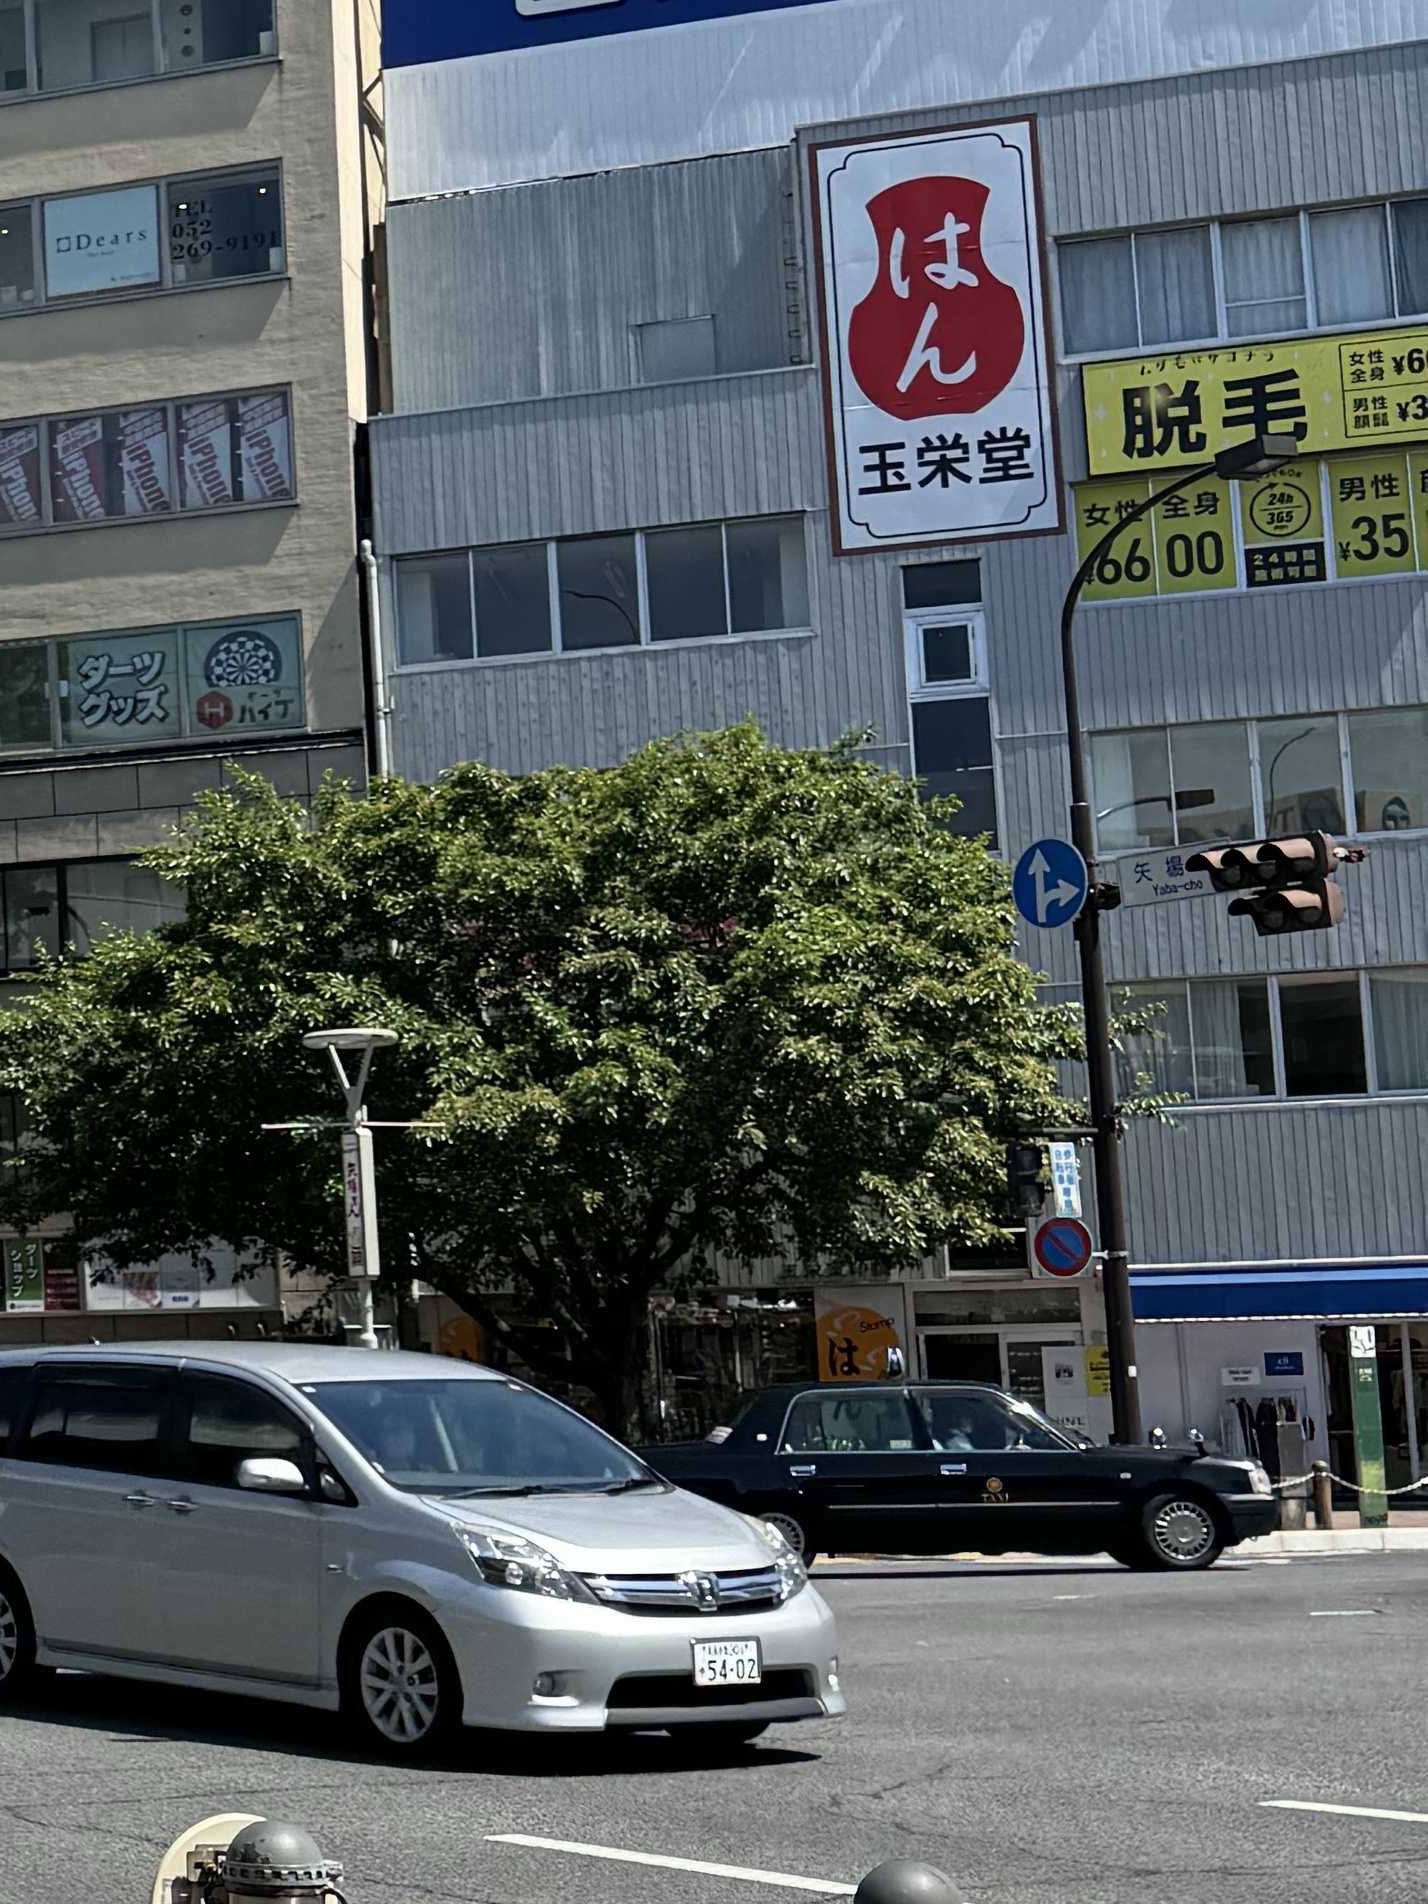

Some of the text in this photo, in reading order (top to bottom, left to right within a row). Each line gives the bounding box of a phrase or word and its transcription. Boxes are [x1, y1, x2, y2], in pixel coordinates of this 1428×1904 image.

[76, 229, 147, 250] Dears
[172, 219, 213, 239] 052
[890, 211, 980, 393] はん
[1349, 348, 1385, 366] 女性
[1350, 366, 1386, 384] 全身
[1122, 368, 1309, 459] 脱毛
[1352, 395, 1388, 413] 男性
[858, 426, 1035, 497] 玉栄堂
[1339, 473, 1401, 502] 男性
[1160, 492, 1221, 520] 全身
[77, 651, 166, 690] ダーツ
[78, 684, 169, 727] グッズ
[1152, 879, 1203, 896] Yaba-cho
